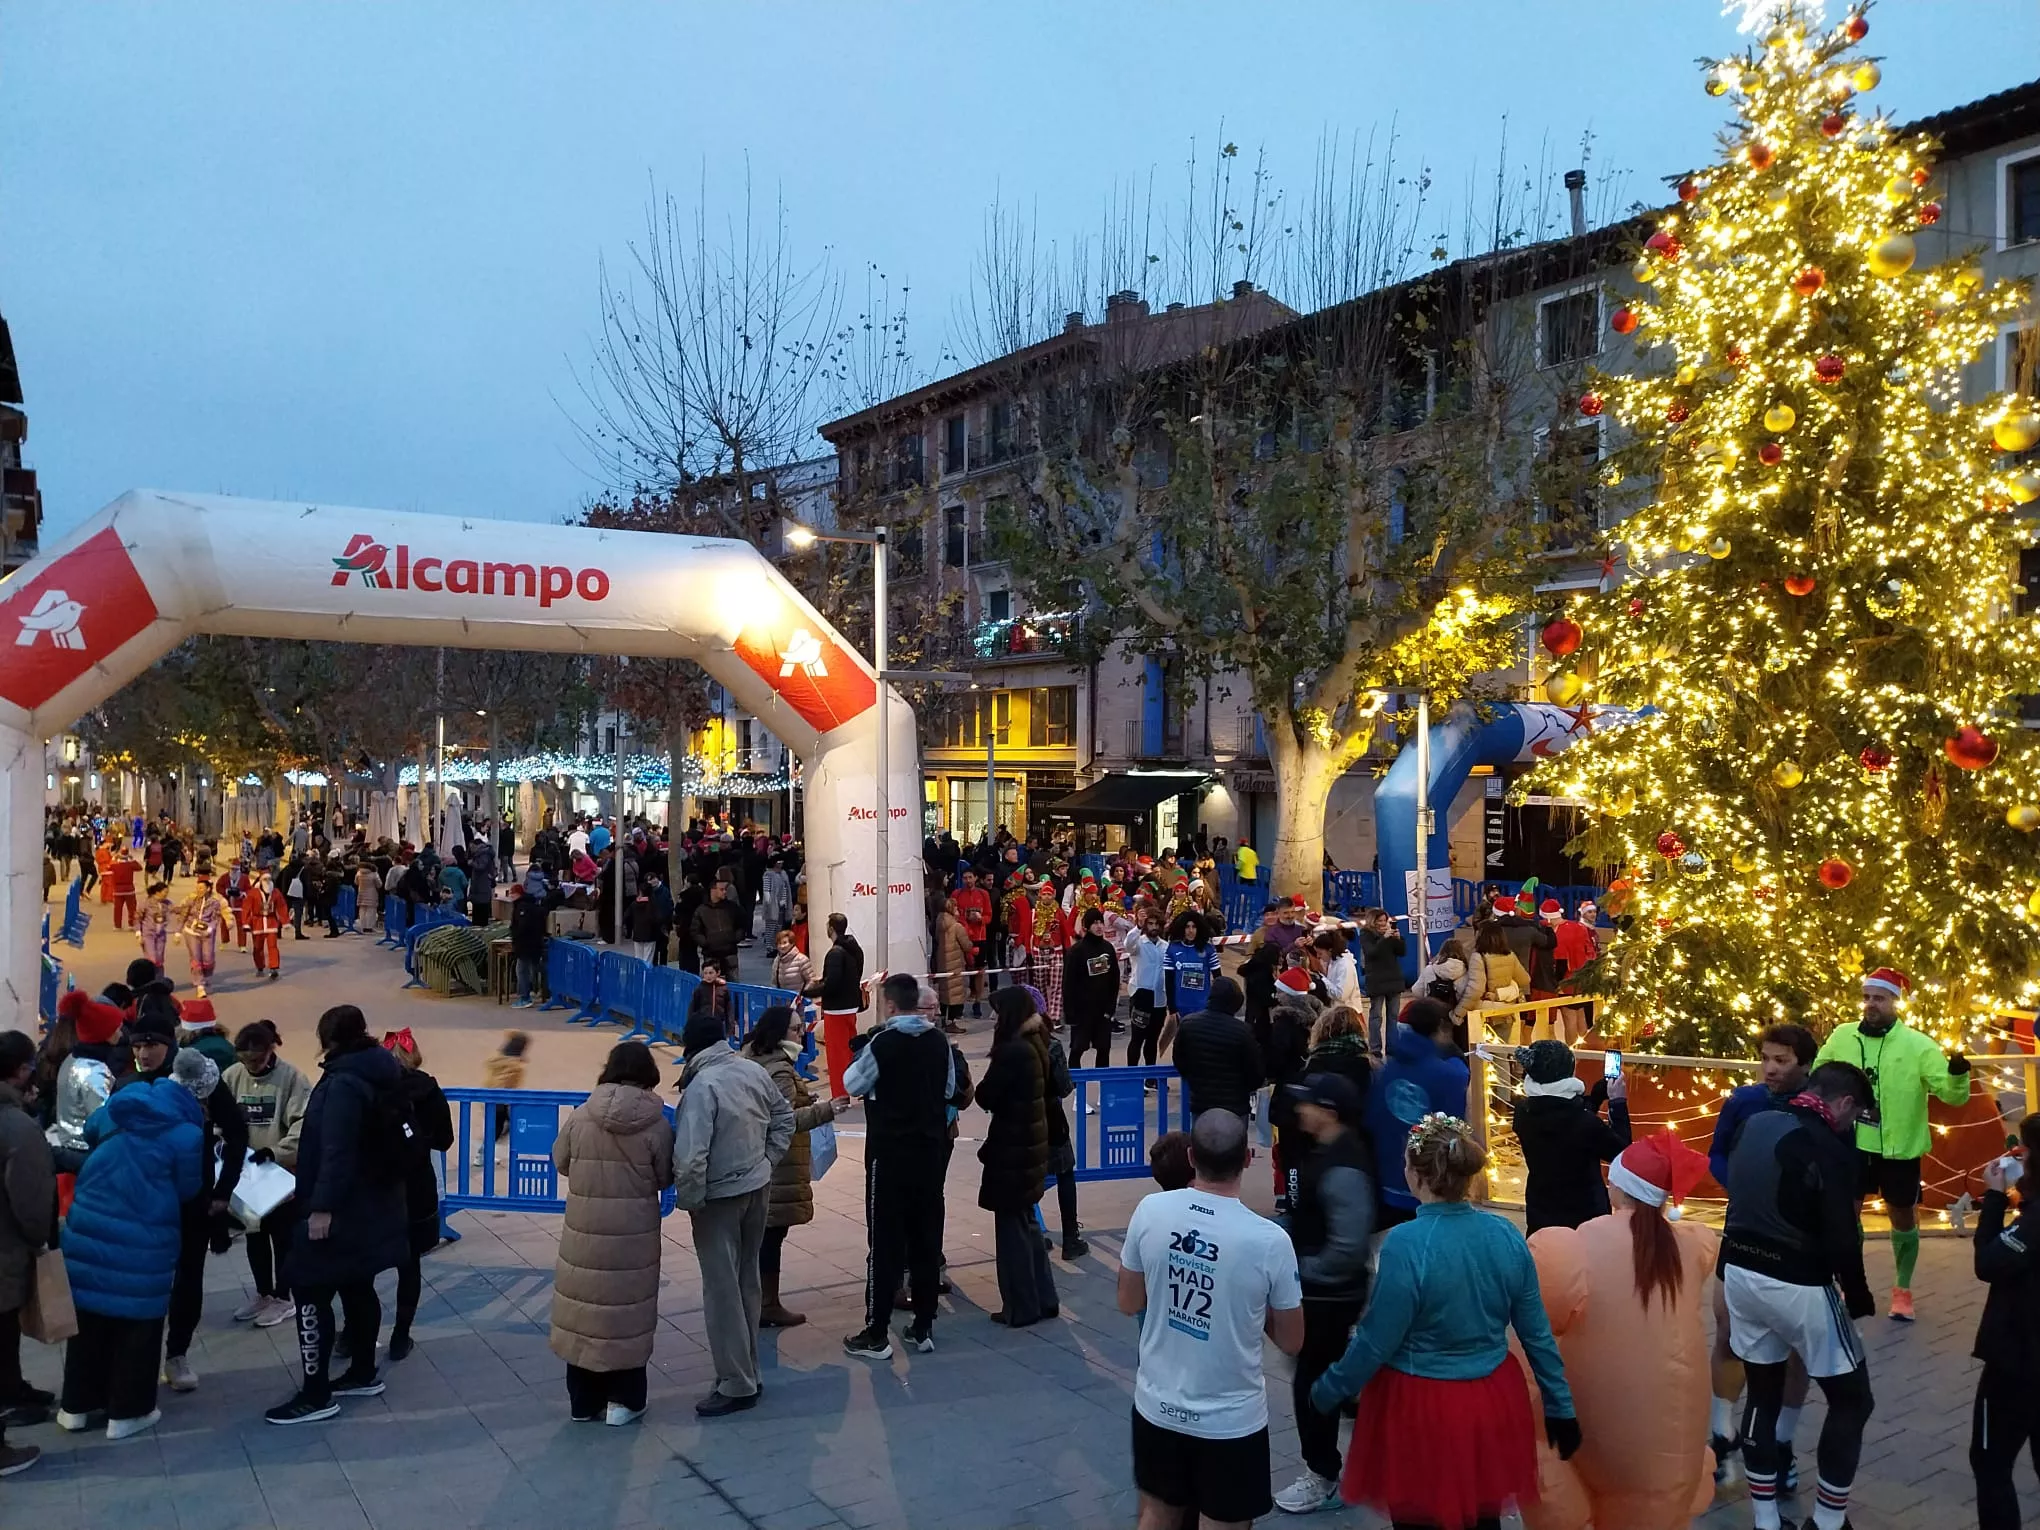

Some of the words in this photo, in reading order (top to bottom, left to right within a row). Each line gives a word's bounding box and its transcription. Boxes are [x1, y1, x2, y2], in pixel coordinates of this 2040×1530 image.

[331, 534, 610, 608] Alcampo
[852, 882, 912, 897] Alcmpo
[1168, 1230, 1219, 1262] 2023
[1168, 1253, 1217, 1275] Movistar
[1168, 1264, 1215, 1291] MAD
[1168, 1283, 1213, 1320] 1/2
[1168, 1307, 1211, 1331] MARATÓN
[301, 1304, 320, 1375] adidas
[1159, 1401, 1200, 1423] Sergio
